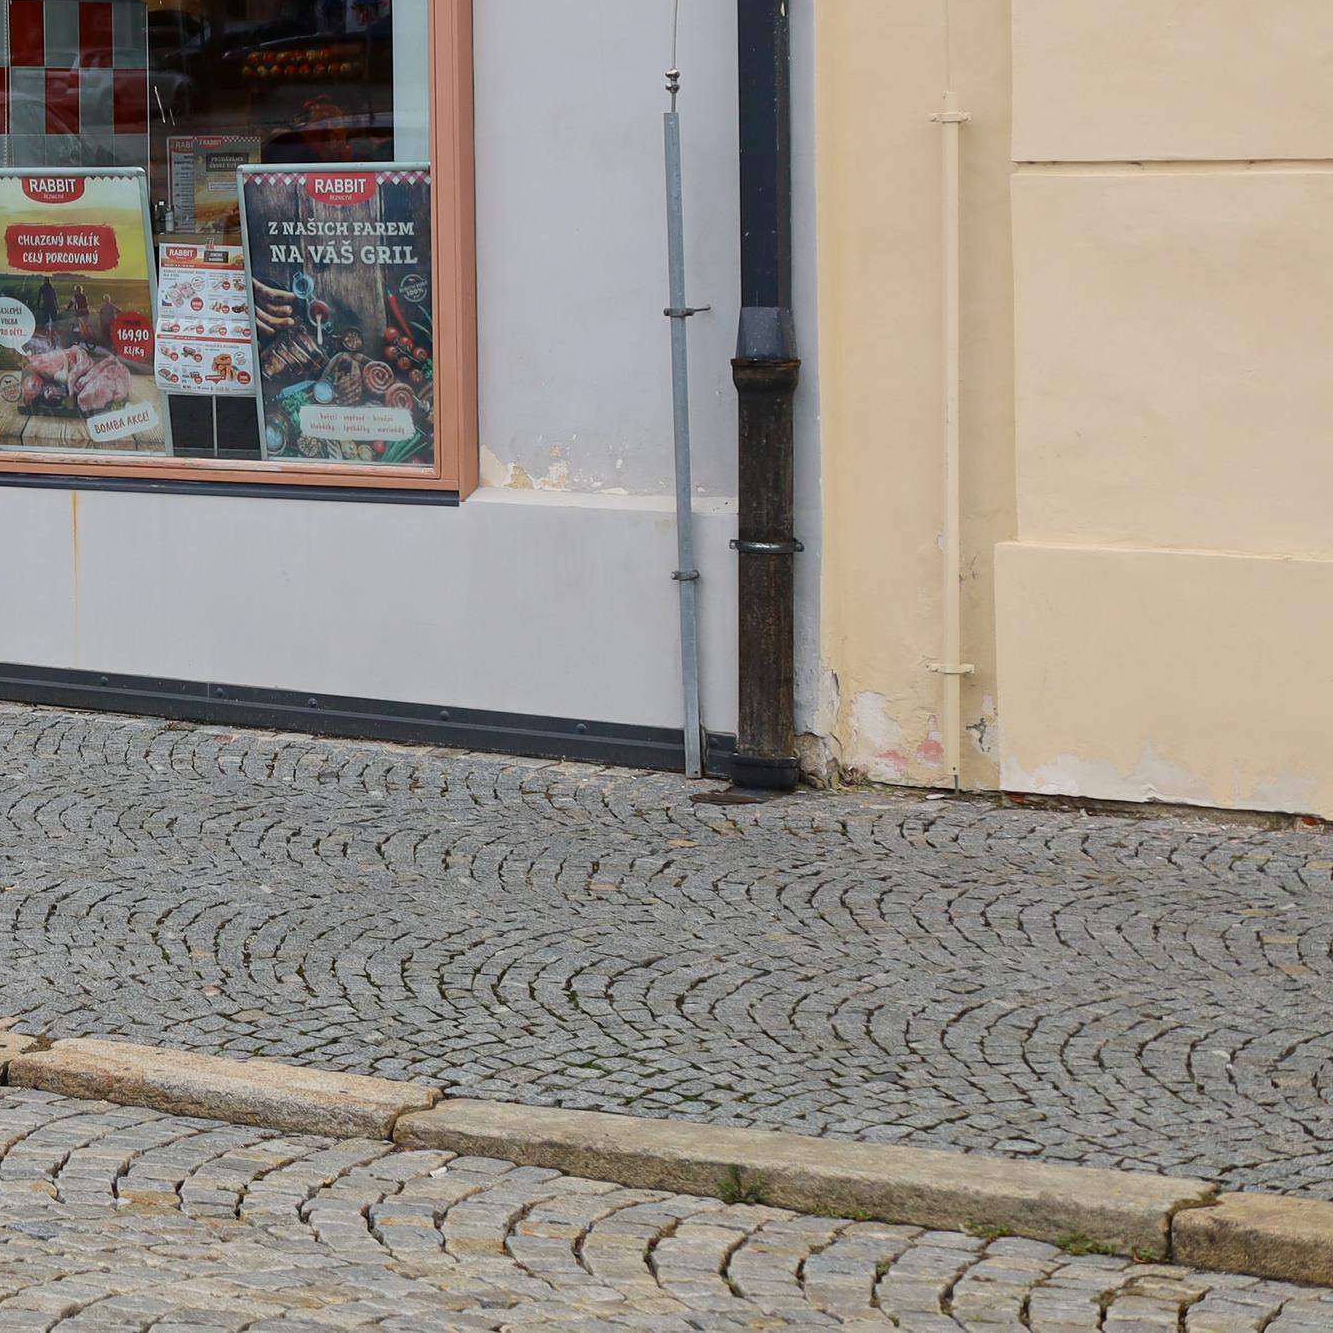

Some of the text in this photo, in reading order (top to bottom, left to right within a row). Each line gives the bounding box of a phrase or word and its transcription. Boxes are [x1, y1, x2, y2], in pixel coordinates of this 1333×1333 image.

[29, 178, 76, 193] RABBIT
[315, 178, 366, 193] RABBIT
[268, 218, 415, 236] Z NAŠICH FAREM
[18, 232, 100, 247] CHLAZENÝ KRÁLÍK
[22, 250, 99, 264] CELÝ PORCOVANÝ
[169, 249, 193, 257] RABBIT
[269, 240, 418, 264] NA VÁŠ GRIL
[117, 328, 149, 343] 169,90
[94, 411, 150, 434] BOMBA AKCE!
